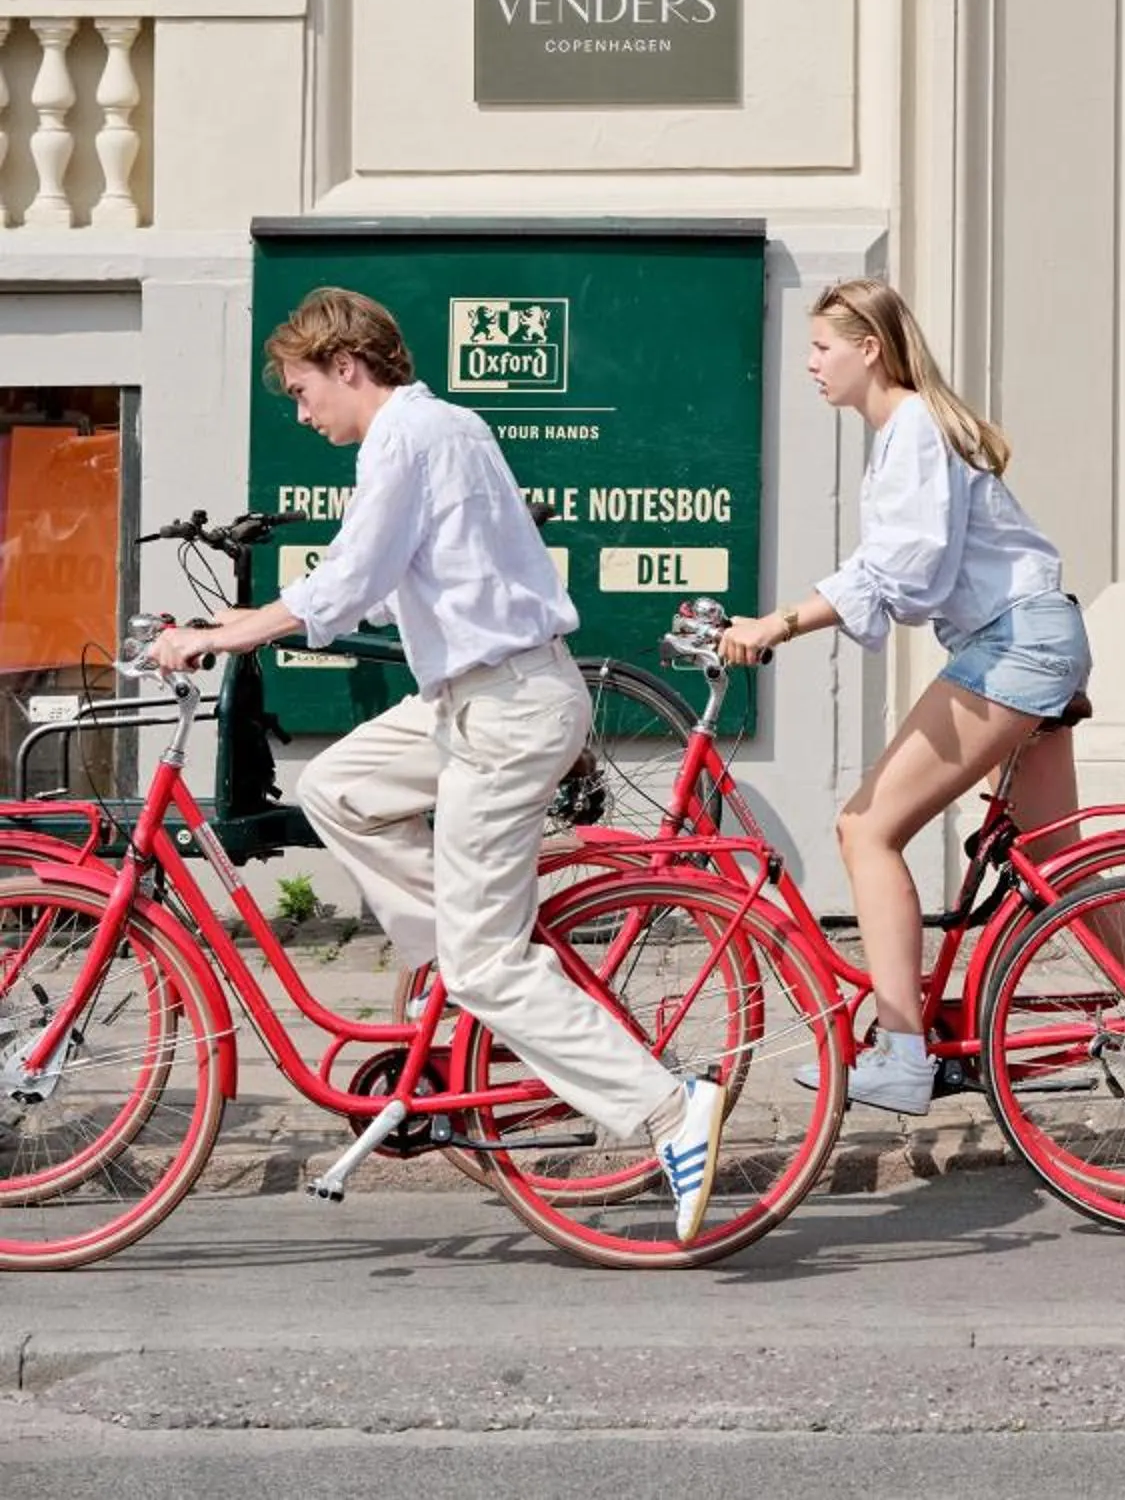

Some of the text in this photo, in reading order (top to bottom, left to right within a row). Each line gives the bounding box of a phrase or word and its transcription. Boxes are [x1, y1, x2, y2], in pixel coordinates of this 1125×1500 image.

[544, 38, 672, 53] COPENHAGEN
[468, 347, 548, 379] Oxford
[497, 425, 600, 440] YOUR HANDS
[278, 485, 357, 521] FREM
[589, 486, 732, 524] NOTESBOG
[637, 553, 689, 586] DEL
